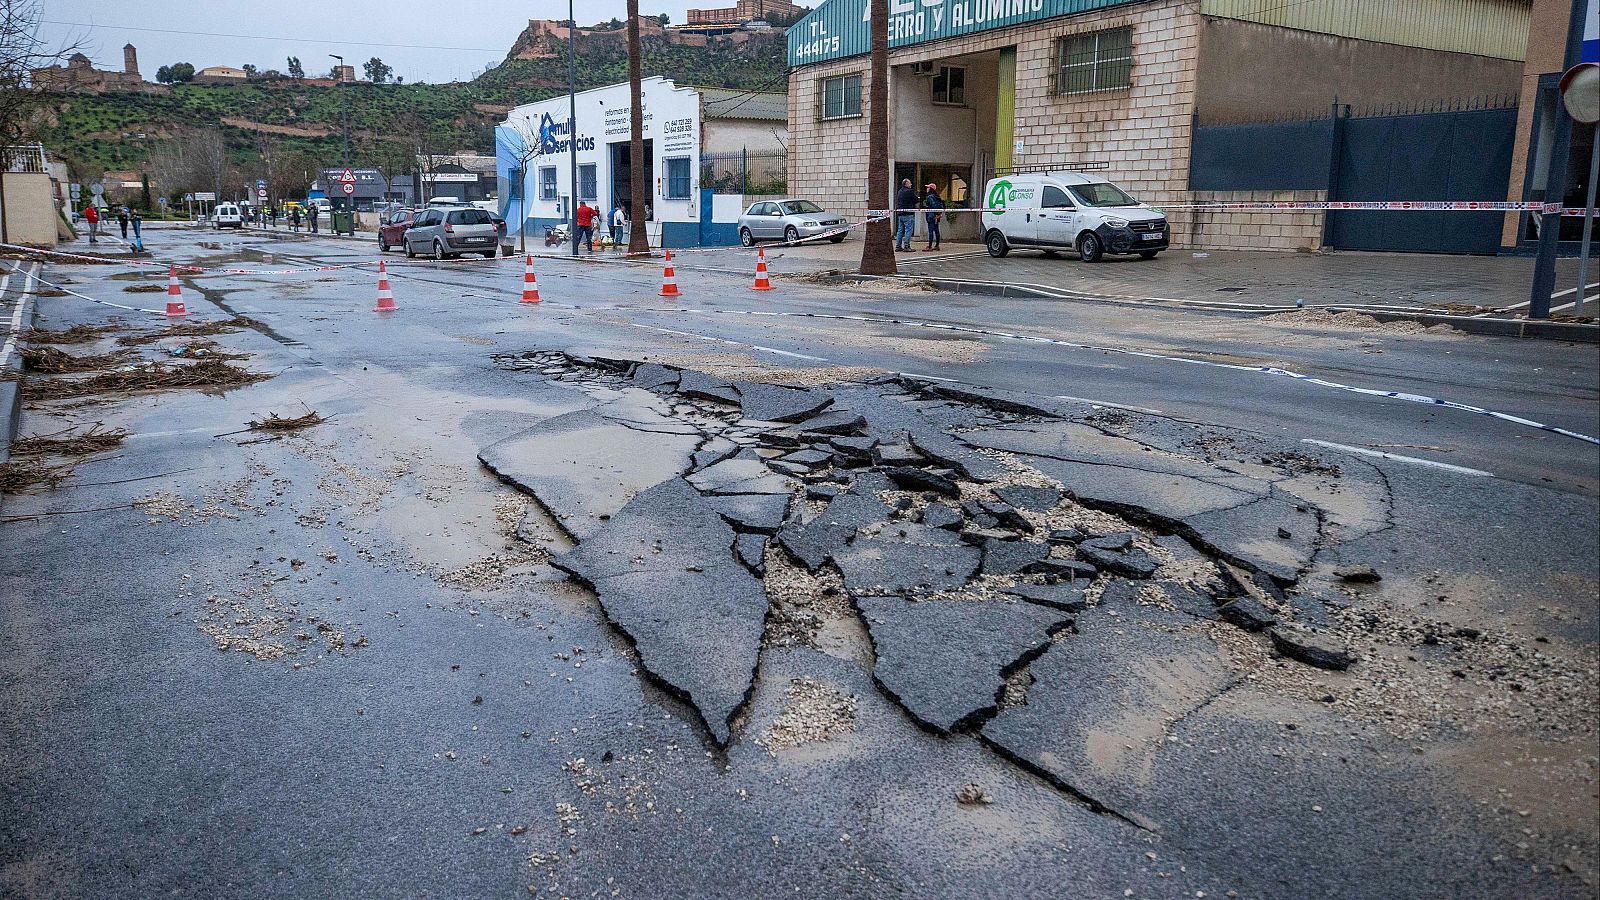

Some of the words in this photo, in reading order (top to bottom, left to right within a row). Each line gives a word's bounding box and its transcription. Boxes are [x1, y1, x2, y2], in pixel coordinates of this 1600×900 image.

[887, 12, 925, 41] ERRO
[933, 7, 945, 32] Y
[796, 35, 840, 58] 444175
